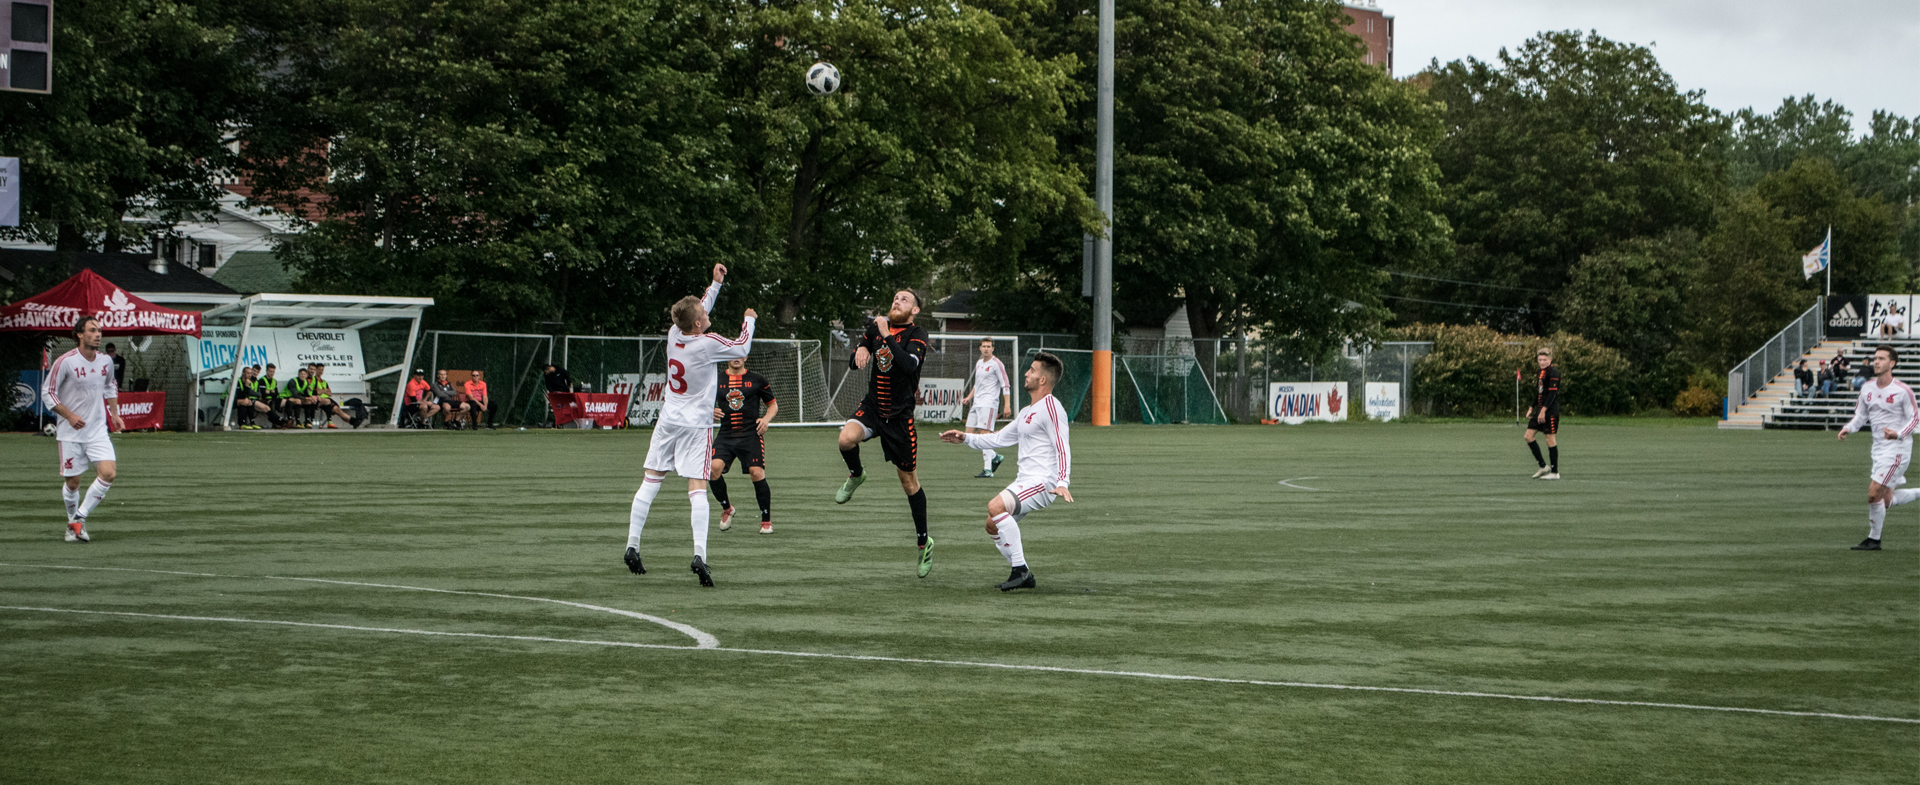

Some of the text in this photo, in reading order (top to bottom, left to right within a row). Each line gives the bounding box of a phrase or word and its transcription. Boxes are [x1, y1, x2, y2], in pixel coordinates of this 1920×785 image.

[1871, 299, 1906, 318] FAR
[1829, 317, 1863, 327] adidas
[296, 332, 345, 341] CHEVROLET
[74, 367, 86, 378] 14
[668, 358, 688, 395] 3
[1278, 385, 1294, 393] MOLSON
[924, 389, 961, 406] CANADIAN
[1866, 392, 1872, 402] 8
[1275, 393, 1321, 417] CANADIAN
[923, 410, 947, 419] LIGHT
